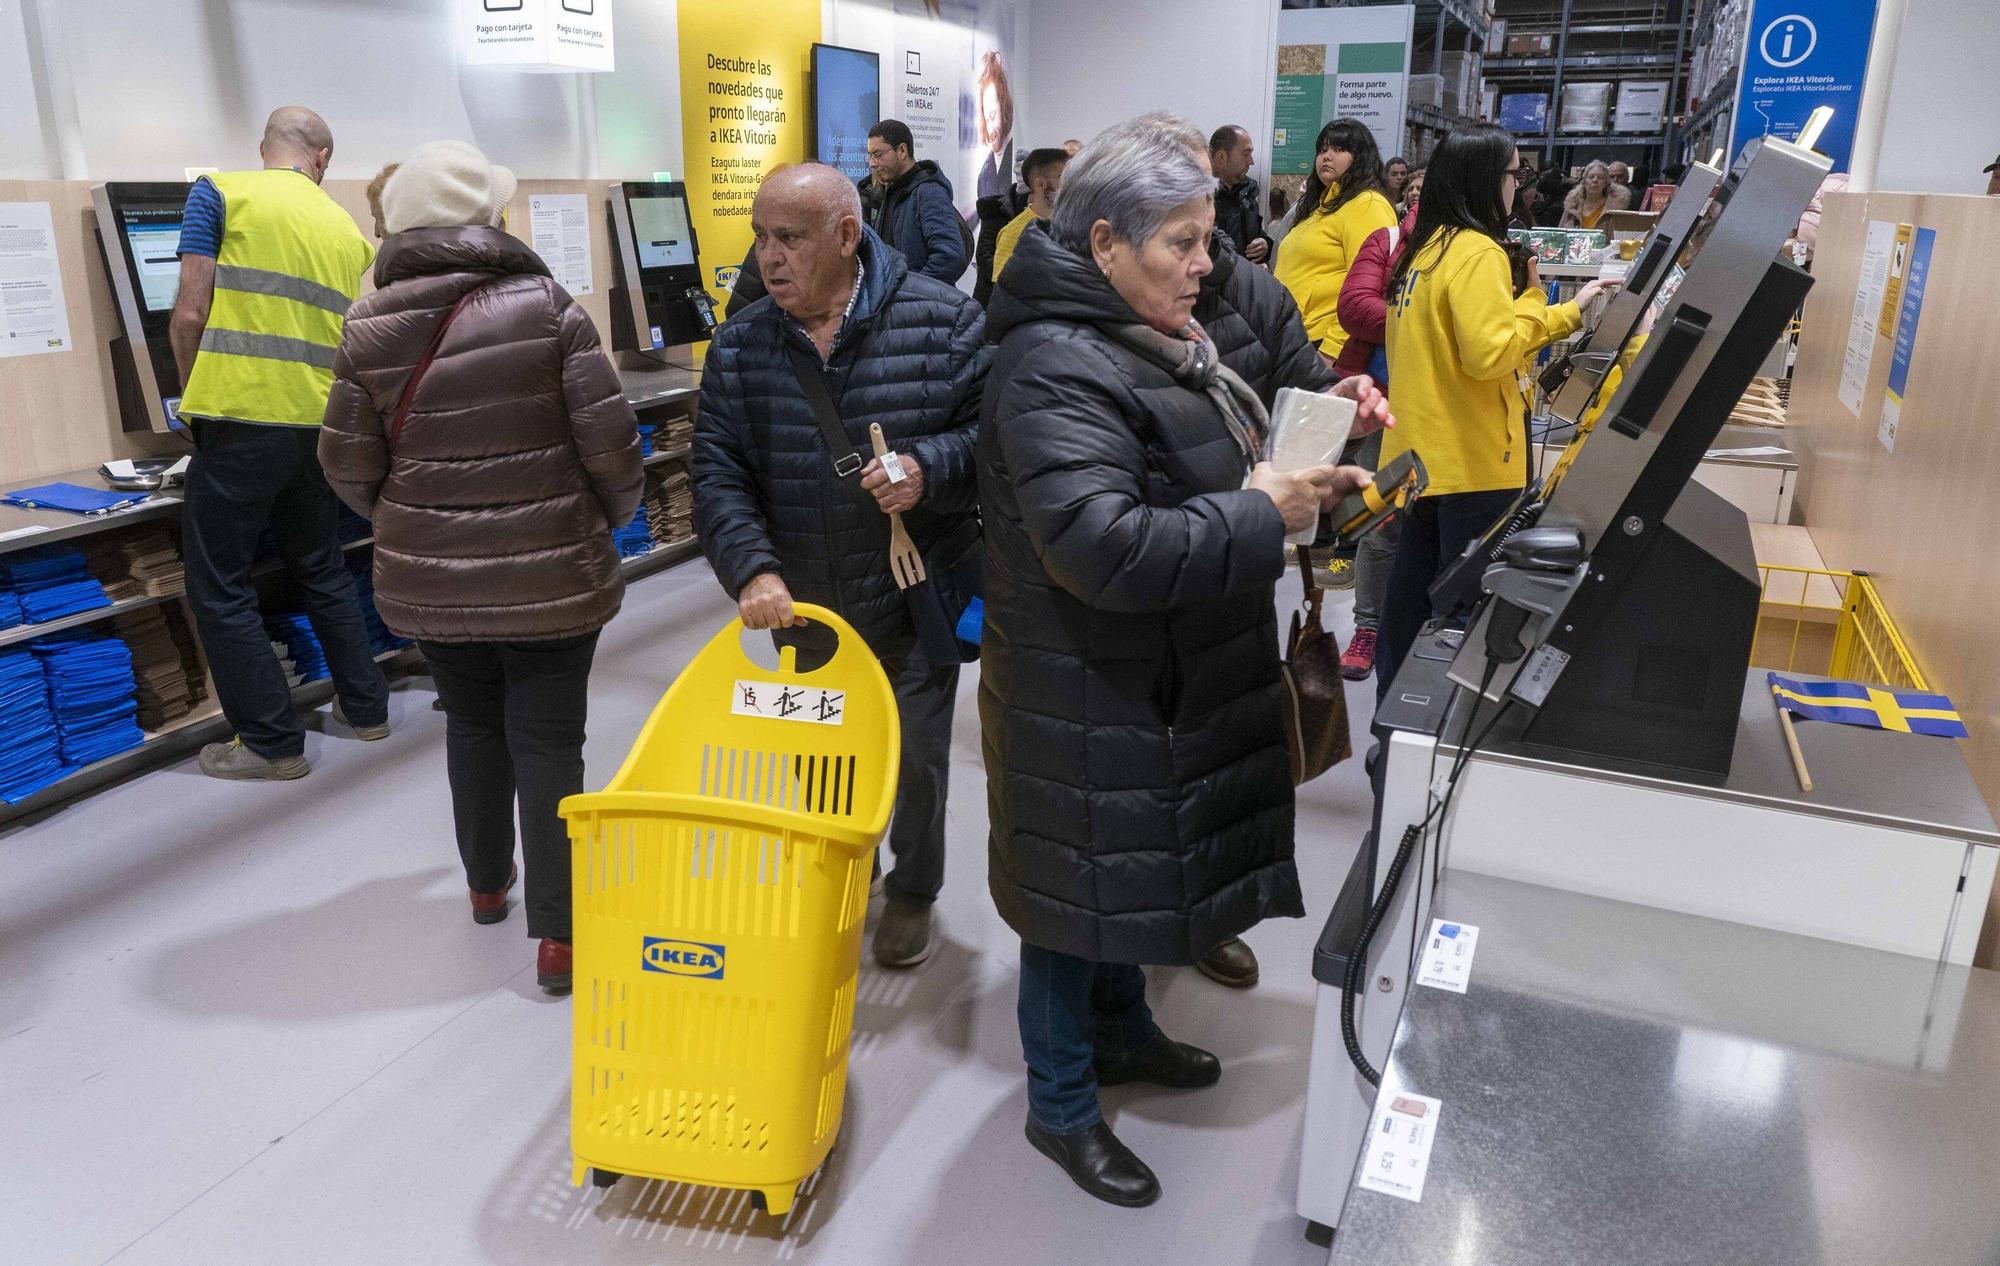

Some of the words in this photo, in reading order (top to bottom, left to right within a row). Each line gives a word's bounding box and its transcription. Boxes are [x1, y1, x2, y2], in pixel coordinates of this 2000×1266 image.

[476, 25, 493, 34] Pago
[508, 23, 532, 32] tarjeta
[556, 24, 571, 35] Pago
[572, 27, 582, 35] con
[583, 28, 602, 39] tarjeta
[708, 53, 755, 74] Descubre
[758, 59, 771, 76] las
[1365, 81, 1387, 90] parte
[1754, 77, 1784, 85] Explora
[1806, 75, 1834, 83] Vitoria
[709, 80, 763, 98] novedades
[765, 87, 783, 103] que
[906, 83, 928, 96] Abiertos
[929, 86, 940, 97] 24/7
[1802, 84, 1852, 92] Vitoria-Gasteiz
[1350, 91, 1366, 100] algo
[906, 100, 914, 108] en
[914, 99, 933, 110] IKEA.es
[709, 106, 744, 123] pronto
[746, 105, 786, 126] llegarán
[710, 130, 717, 142] a
[719, 128, 742, 144] IKEA
[744, 129, 777, 145] Vitoria
[838, 151, 869, 162] aventura
[711, 156, 740, 170] Ezagutu
[742, 157, 762, 168] laster
[712, 174, 729, 184] IKEA
[712, 189, 742, 201] dendara
[743, 188, 759, 199] irits
[713, 205, 752, 217] nobedadea
[651, 947, 717, 968] IKEA
